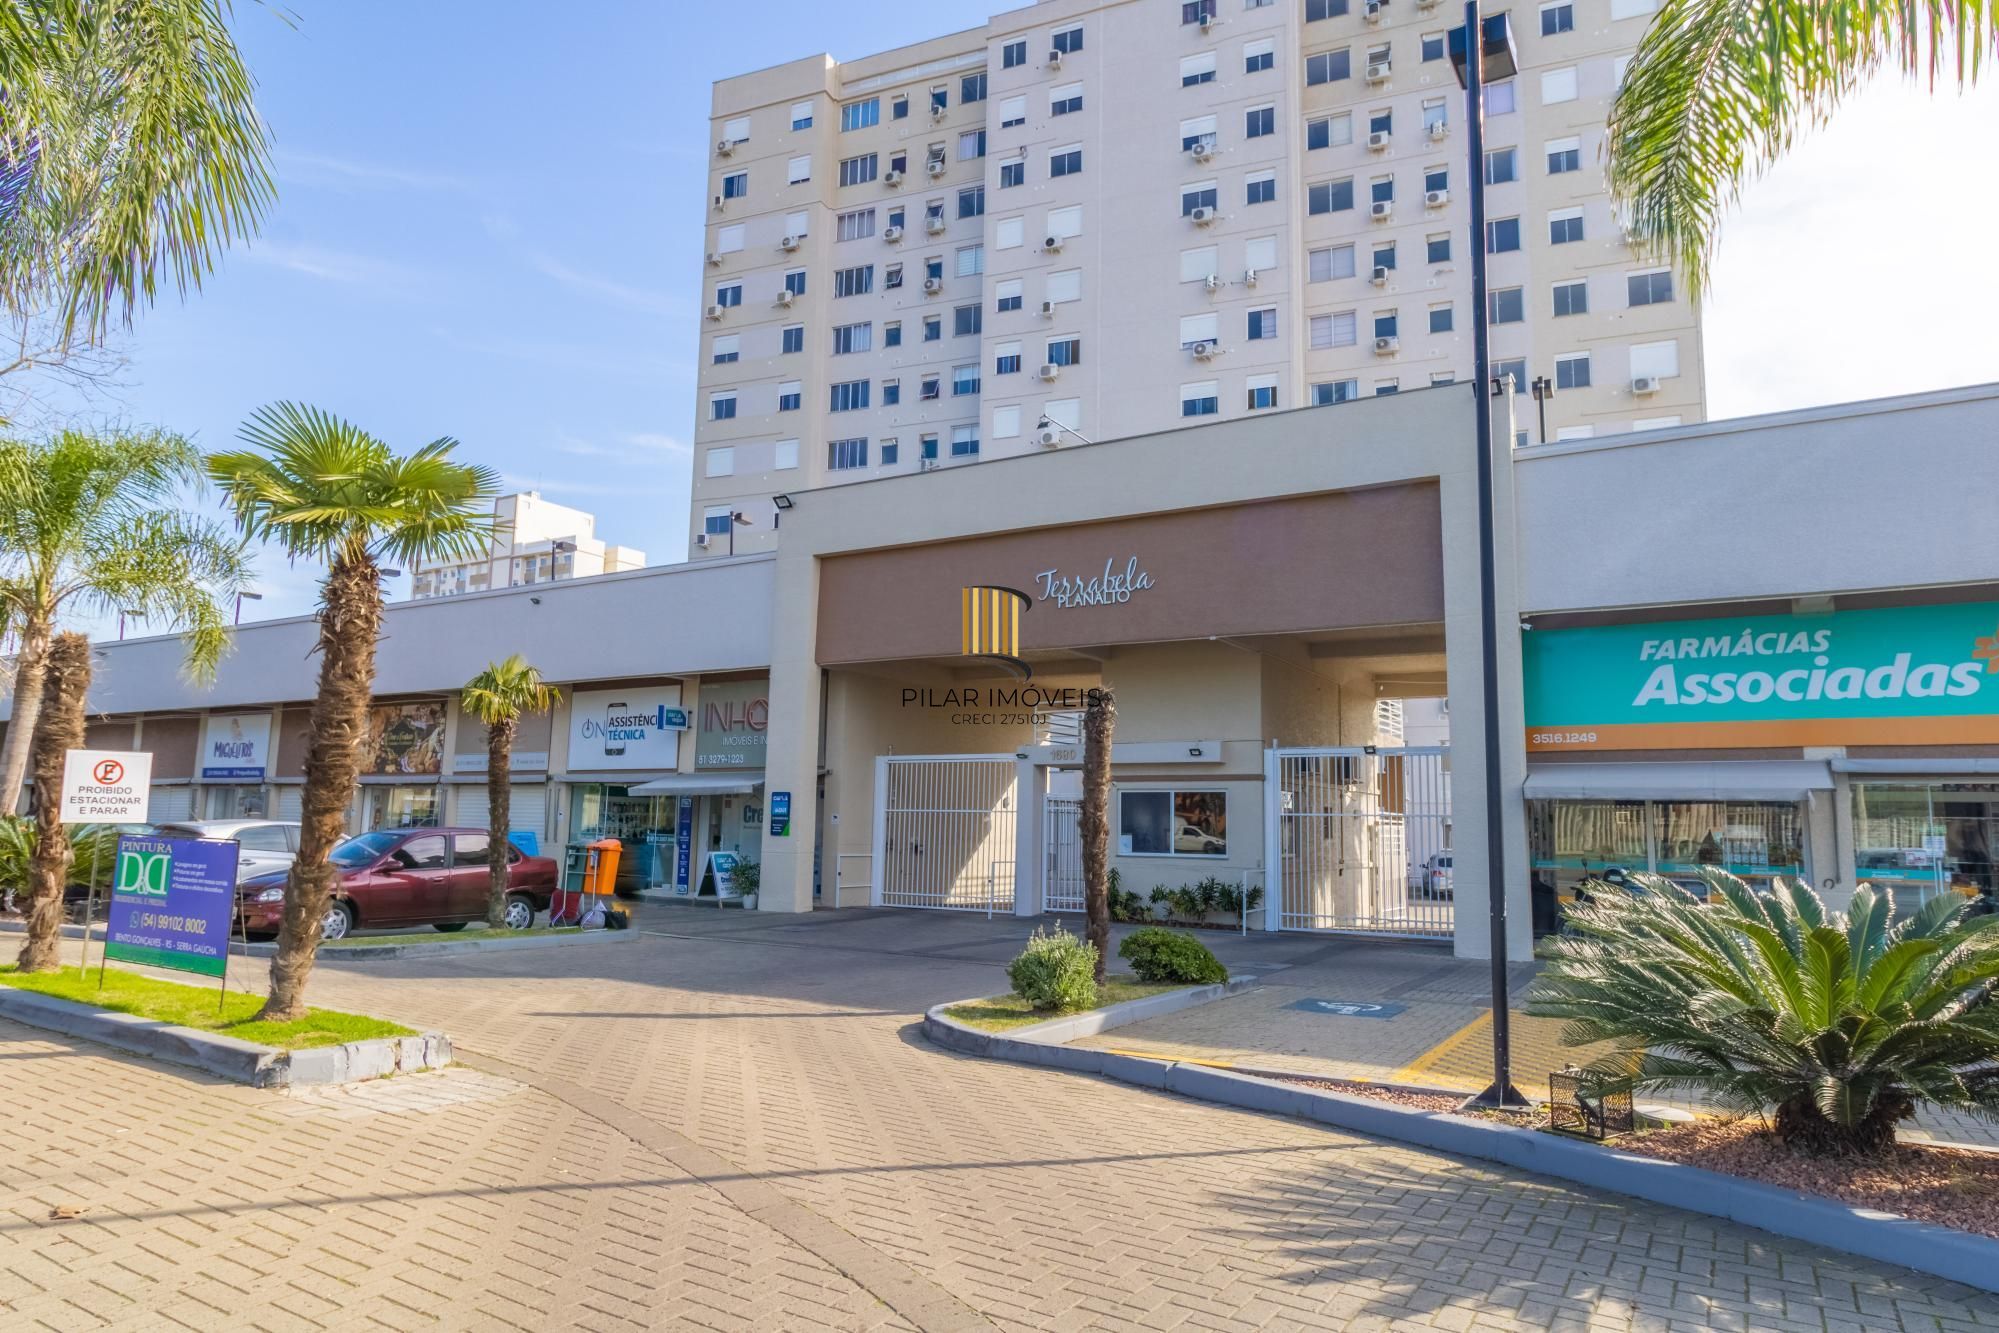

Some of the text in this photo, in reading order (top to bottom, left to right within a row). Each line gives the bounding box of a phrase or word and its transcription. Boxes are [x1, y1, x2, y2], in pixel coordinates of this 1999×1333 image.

[1035, 556, 1156, 601] Terrabela
[1058, 588, 1130, 608] PLANALTO
[1639, 628, 1832, 661] FARMÁCIAS
[1631, 652, 1983, 706] Associadas
[608, 728, 646, 741] TÉCNICA
[722, 734, 751, 746] IMÓVEIS
[1532, 732, 1597, 744] 3516.1249
[78, 785, 133, 795] PROIBIDO
[69, 796, 141, 805] ESTACIONAR
[79, 806, 128, 815] E PARAR
[121, 840, 172, 854] PINTURA
[141, 912, 207, 935] (54) 99102 8002
